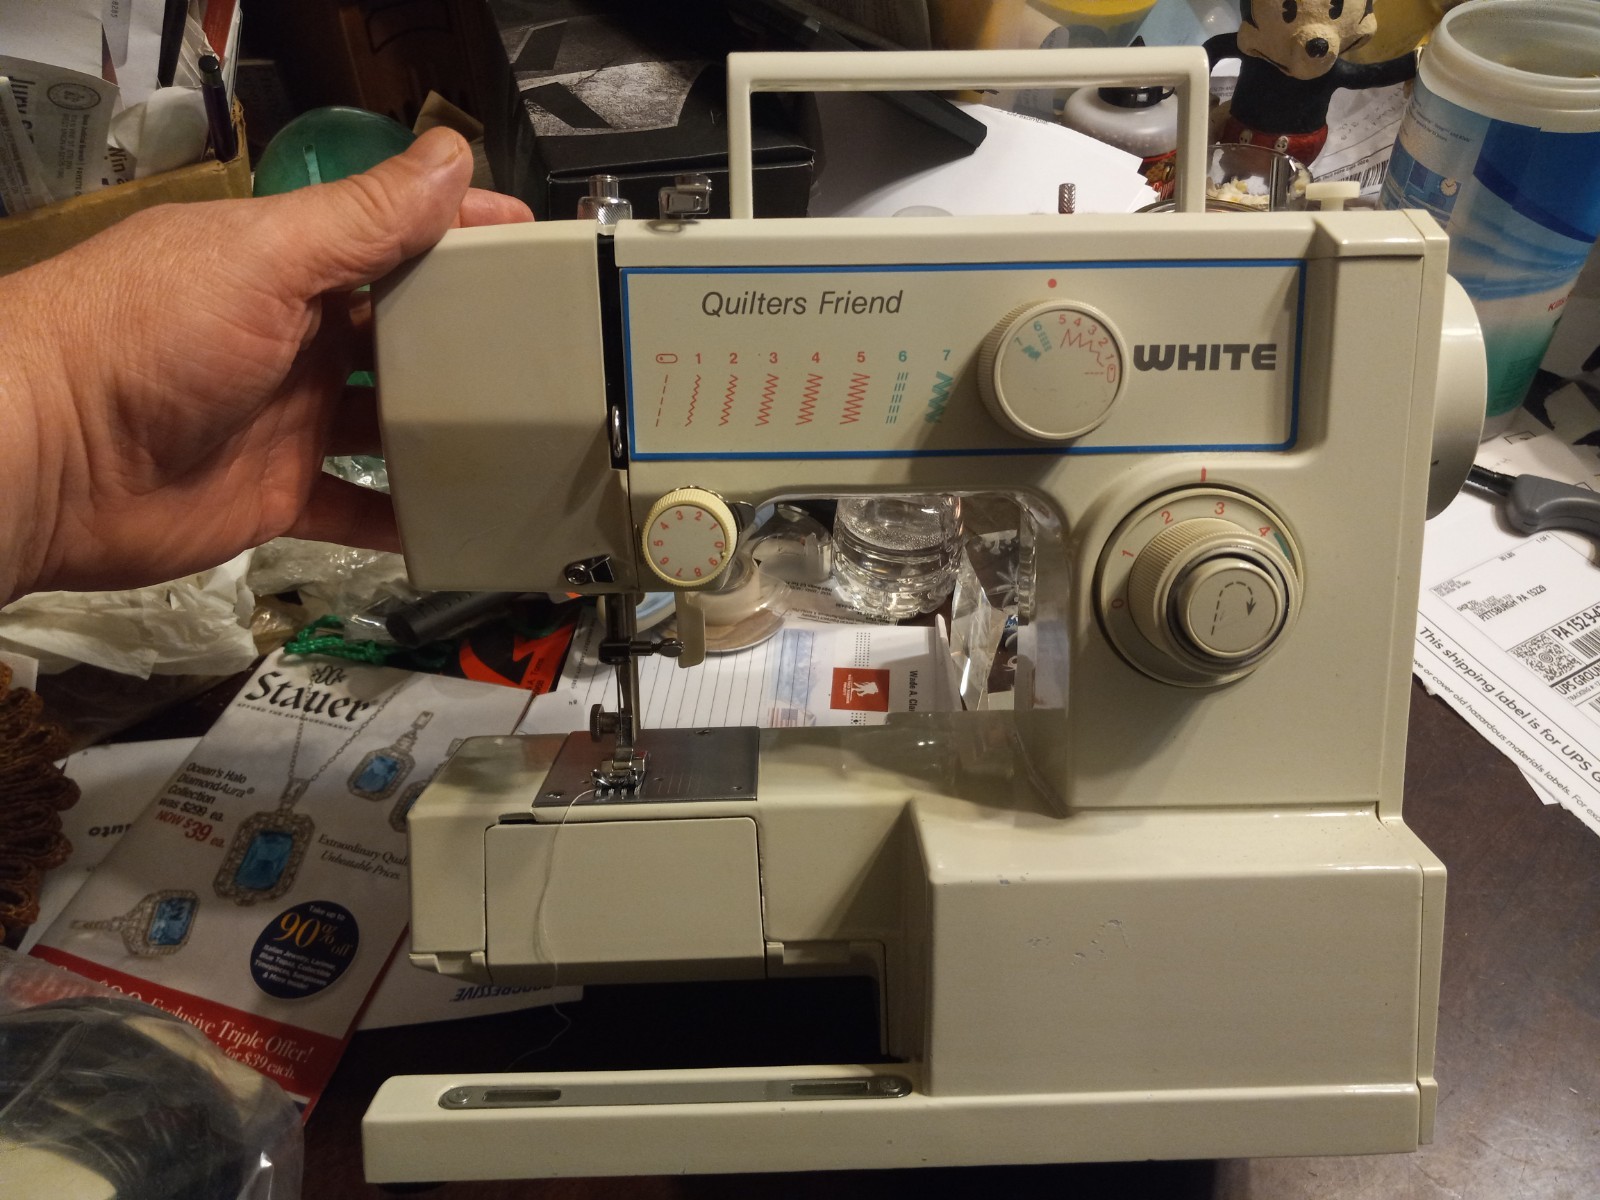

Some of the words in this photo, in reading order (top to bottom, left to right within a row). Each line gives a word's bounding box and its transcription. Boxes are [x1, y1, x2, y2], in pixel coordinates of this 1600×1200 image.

[701, 291, 807, 317] Quilters
[818, 290, 904, 315] Friend
[1013, 336, 1023, 346] 7
[1033, 321, 1042, 332] 6
[1058, 314, 1067, 325] 5
[1073, 317, 1082, 327] 4
[1088, 324, 1098, 336] 3
[1098, 337, 1109, 347] 2
[1105, 353, 1114, 361] 1
[695, 353, 702, 364] 1
[729, 353, 738, 364] 2
[769, 353, 778, 363] 3
[811, 352, 821, 363] 4
[857, 351, 866, 363] 5
[898, 350, 907, 362] 6
[943, 350, 951, 361] 7
[1133, 344, 1277, 371] WHITE
[660, 522, 669, 530] 4
[676, 510, 683, 520] 3
[694, 511, 702, 520] 2
[1111, 598, 1124, 609] 0
[1122, 550, 1134, 558] 1
[1161, 510, 1173, 524] 2
[1214, 502, 1225, 515] 3
[1259, 526, 1271, 537] 4
[675, 568, 682, 577] 7
[694, 567, 702, 577] 8
[1479, 600, 1516, 622] PITTSBURGH
[1516, 594, 1527, 602] PA
[1527, 584, 1547, 597] 15229
[1551, 626, 1573, 640] PA
[1566, 616, 1590, 632] 152
[908, 670, 918, 689] Wade
[1555, 679, 1577, 695] UPS
[244, 671, 370, 722] Stauer
[1419, 626, 1444, 649] This
[1443, 648, 1496, 693] shipping
[1494, 691, 1527, 720] label
[1527, 716, 1541, 730] is
[1540, 728, 1561, 747] for
[1561, 744, 1593, 772] UPS
[1424, 667, 1433, 677] or
[1432, 675, 1453, 695] cover
[1453, 693, 1466, 707] old
[1467, 704, 1507, 742] hazardous
[1506, 737, 1545, 773] materials
[1544, 770, 1570, 797] labels.
[1571, 794, 1586, 808] For
[224, 770, 247, 784] Halo
[168, 784, 216, 804] Collection
[155, 809, 186, 826] NOW
[182, 818, 213, 842] $39
[319, 833, 380, 861] Extraordinary
[217, 1019, 264, 1051] Triple
[265, 1034, 313, 1063] Offer!
[241, 1052, 268, 1069] $39
